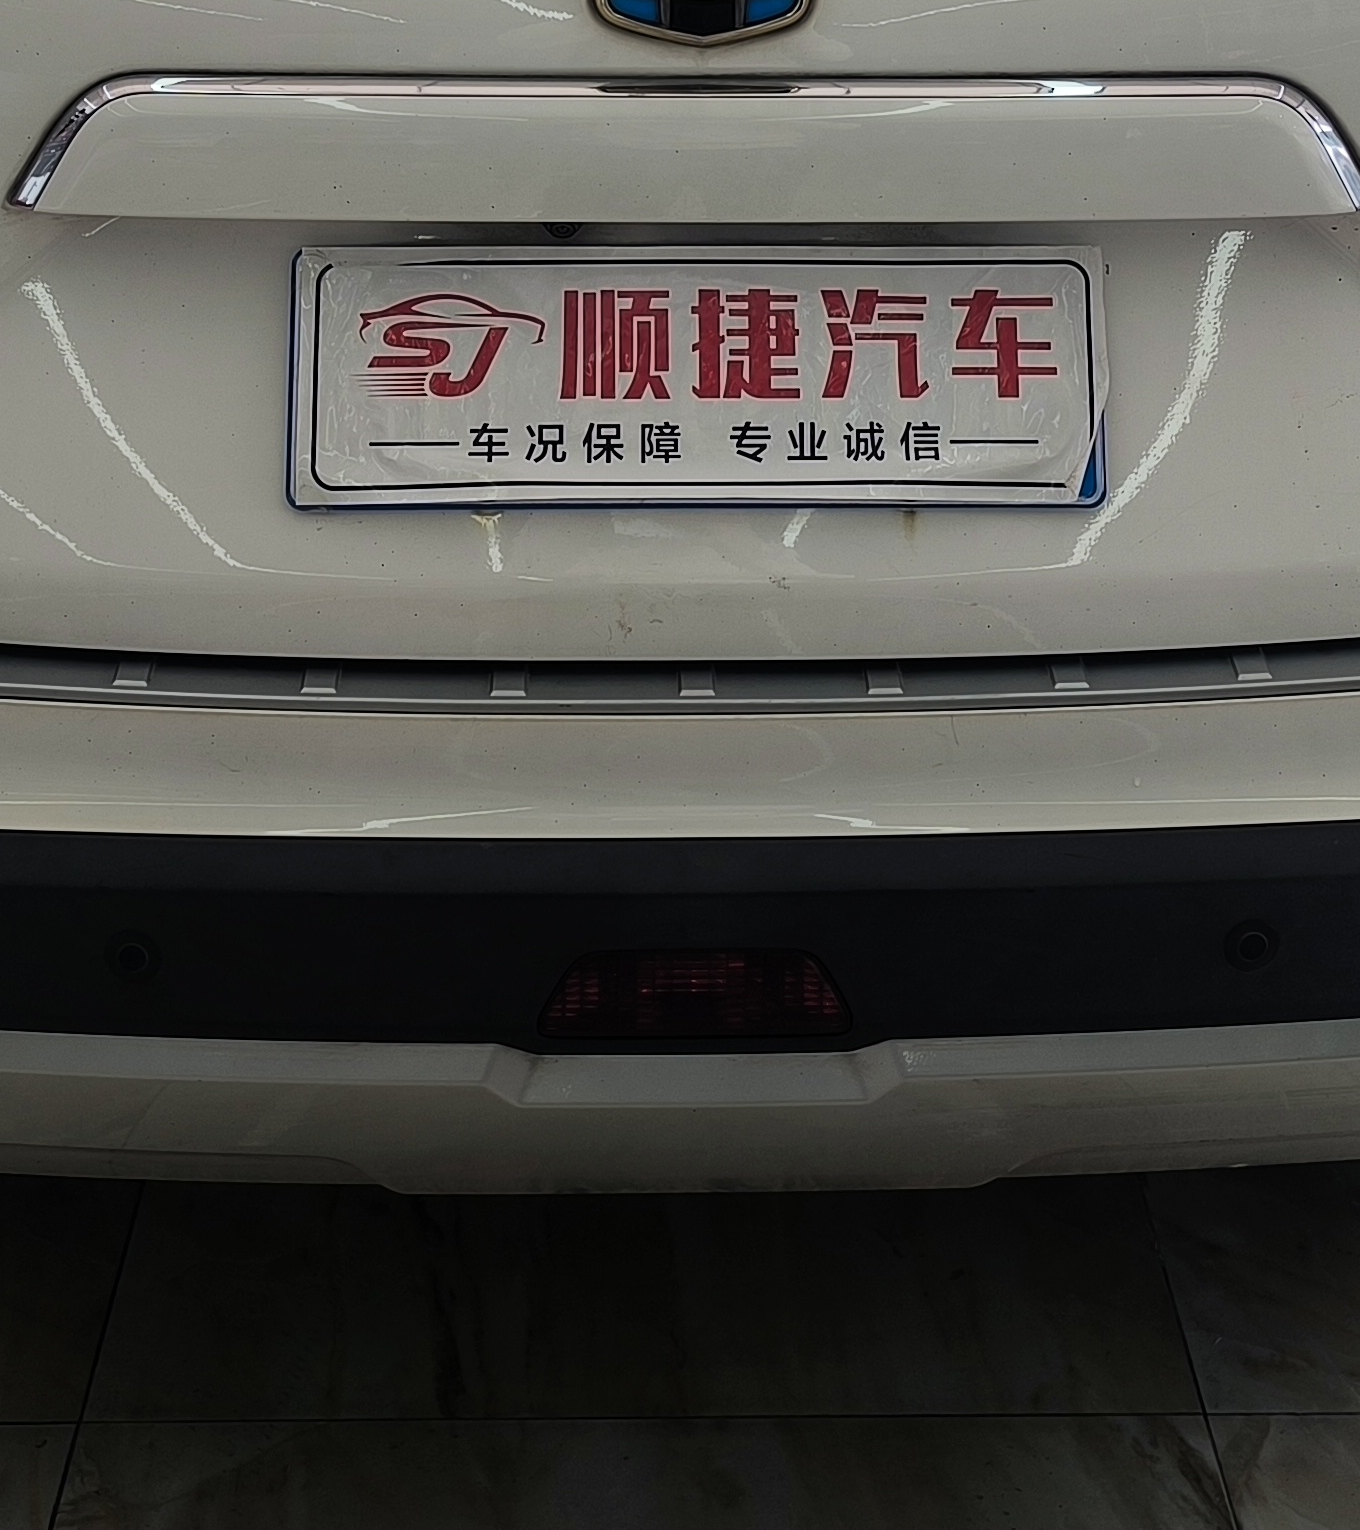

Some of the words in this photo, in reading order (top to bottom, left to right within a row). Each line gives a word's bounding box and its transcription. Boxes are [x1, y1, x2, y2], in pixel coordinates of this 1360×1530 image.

[560, 288, 1059, 401] 顺捷汽车
[467, 421, 683, 465] 车况保障
[729, 421, 943, 464] 专业诚信
